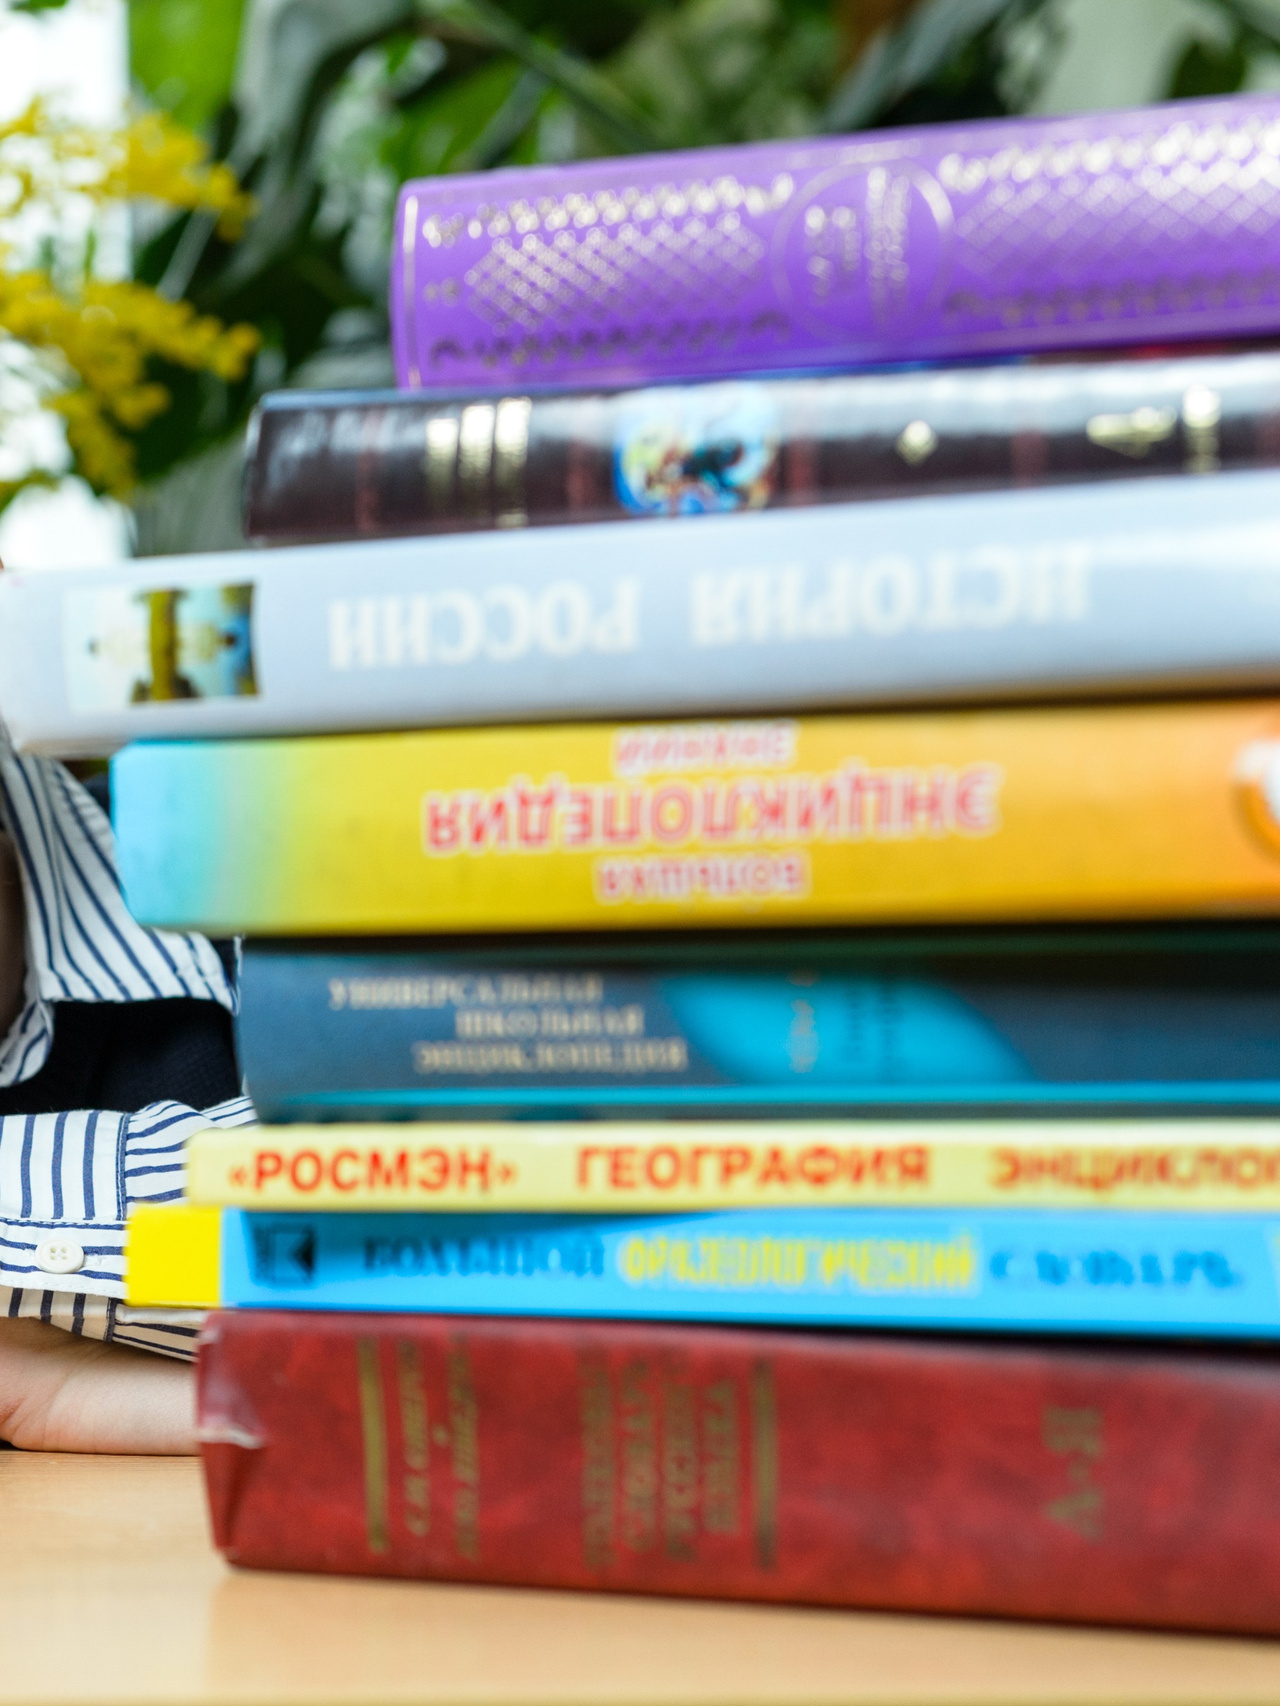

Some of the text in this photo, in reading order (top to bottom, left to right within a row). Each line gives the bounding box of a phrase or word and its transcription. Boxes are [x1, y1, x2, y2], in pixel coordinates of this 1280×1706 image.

[330, 545, 1094, 669] ИСТОРИЯ РОССИИ
[428, 767, 998, 850] ЭНЦИКЛОПЕДИЯ
[228, 1147, 516, 1193] «РОСМЭН»
[576, 1145, 930, 1191] ГЕОГРАФИЯ
